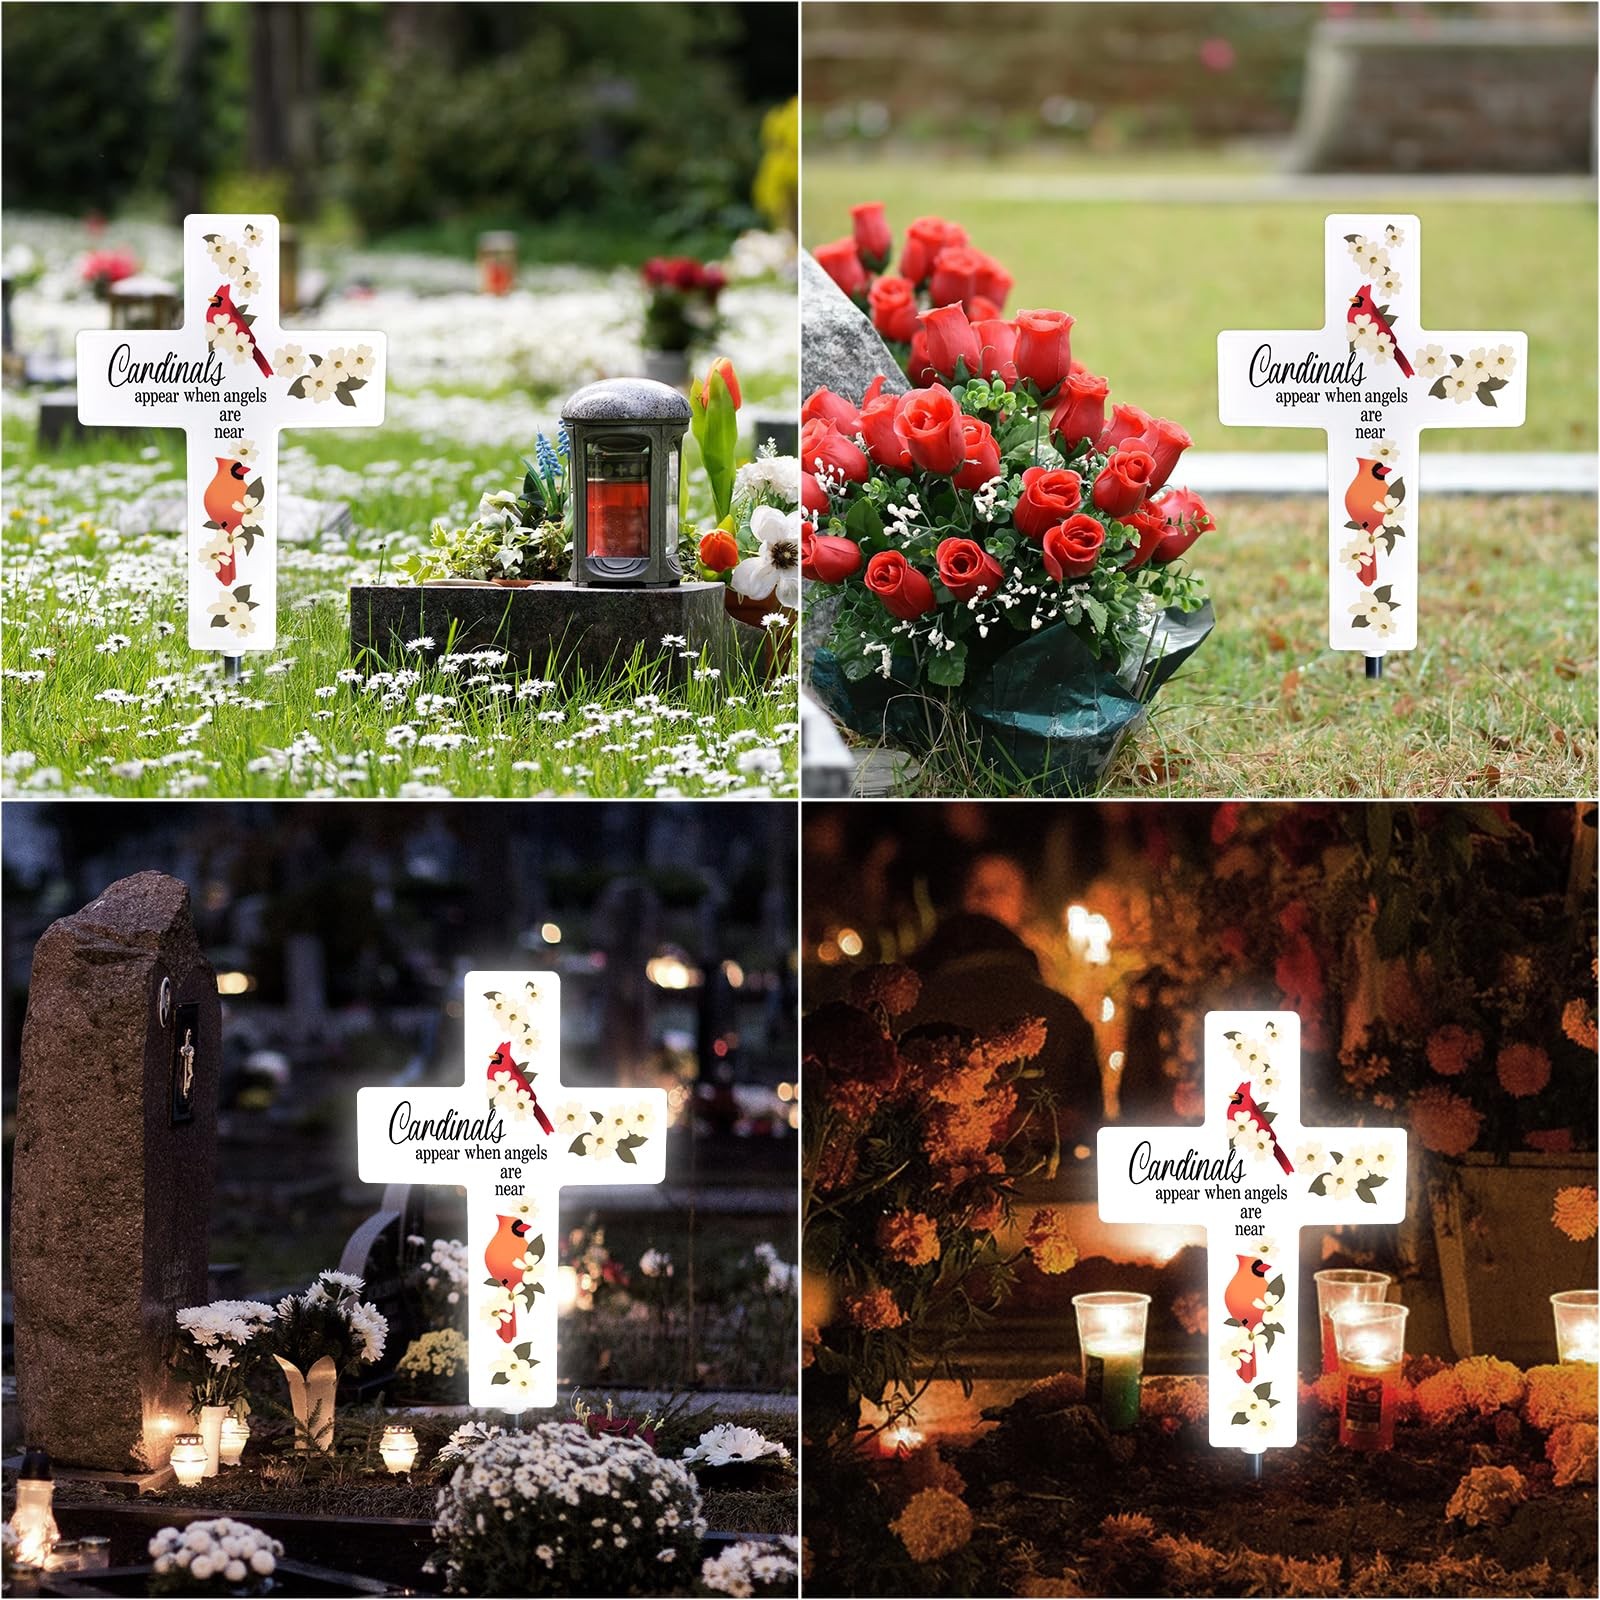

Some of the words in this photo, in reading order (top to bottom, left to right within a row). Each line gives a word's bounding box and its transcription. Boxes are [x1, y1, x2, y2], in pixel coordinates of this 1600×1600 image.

[108, 343, 226, 388] Cardinals
[1248, 343, 1368, 388] Cardinals
[135, 391, 180, 407] appear
[184, 386, 221, 403] when
[224, 386, 267, 407] angels
[1275, 391, 1320, 407] appear
[1324, 386, 1362, 403] when
[1365, 386, 1408, 408] angels
[219, 409, 242, 422] are
[1360, 409, 1383, 423] are
[214, 427, 245, 439] near
[1355, 427, 1385, 439] near
[388, 1101, 507, 1145] Cardinals
[415, 1148, 461, 1164] appear
[464, 1143, 501, 1160] when
[504, 1143, 548, 1165] angels
[1128, 1141, 1247, 1185] Cardinals
[499, 1167, 522, 1179] are
[495, 1184, 526, 1197] near
[1155, 1188, 1201, 1204] appear
[1204, 1183, 1242, 1200] when
[1244, 1183, 1288, 1205] angels
[1239, 1207, 1262, 1220] are
[1234, 1224, 1266, 1237] near
